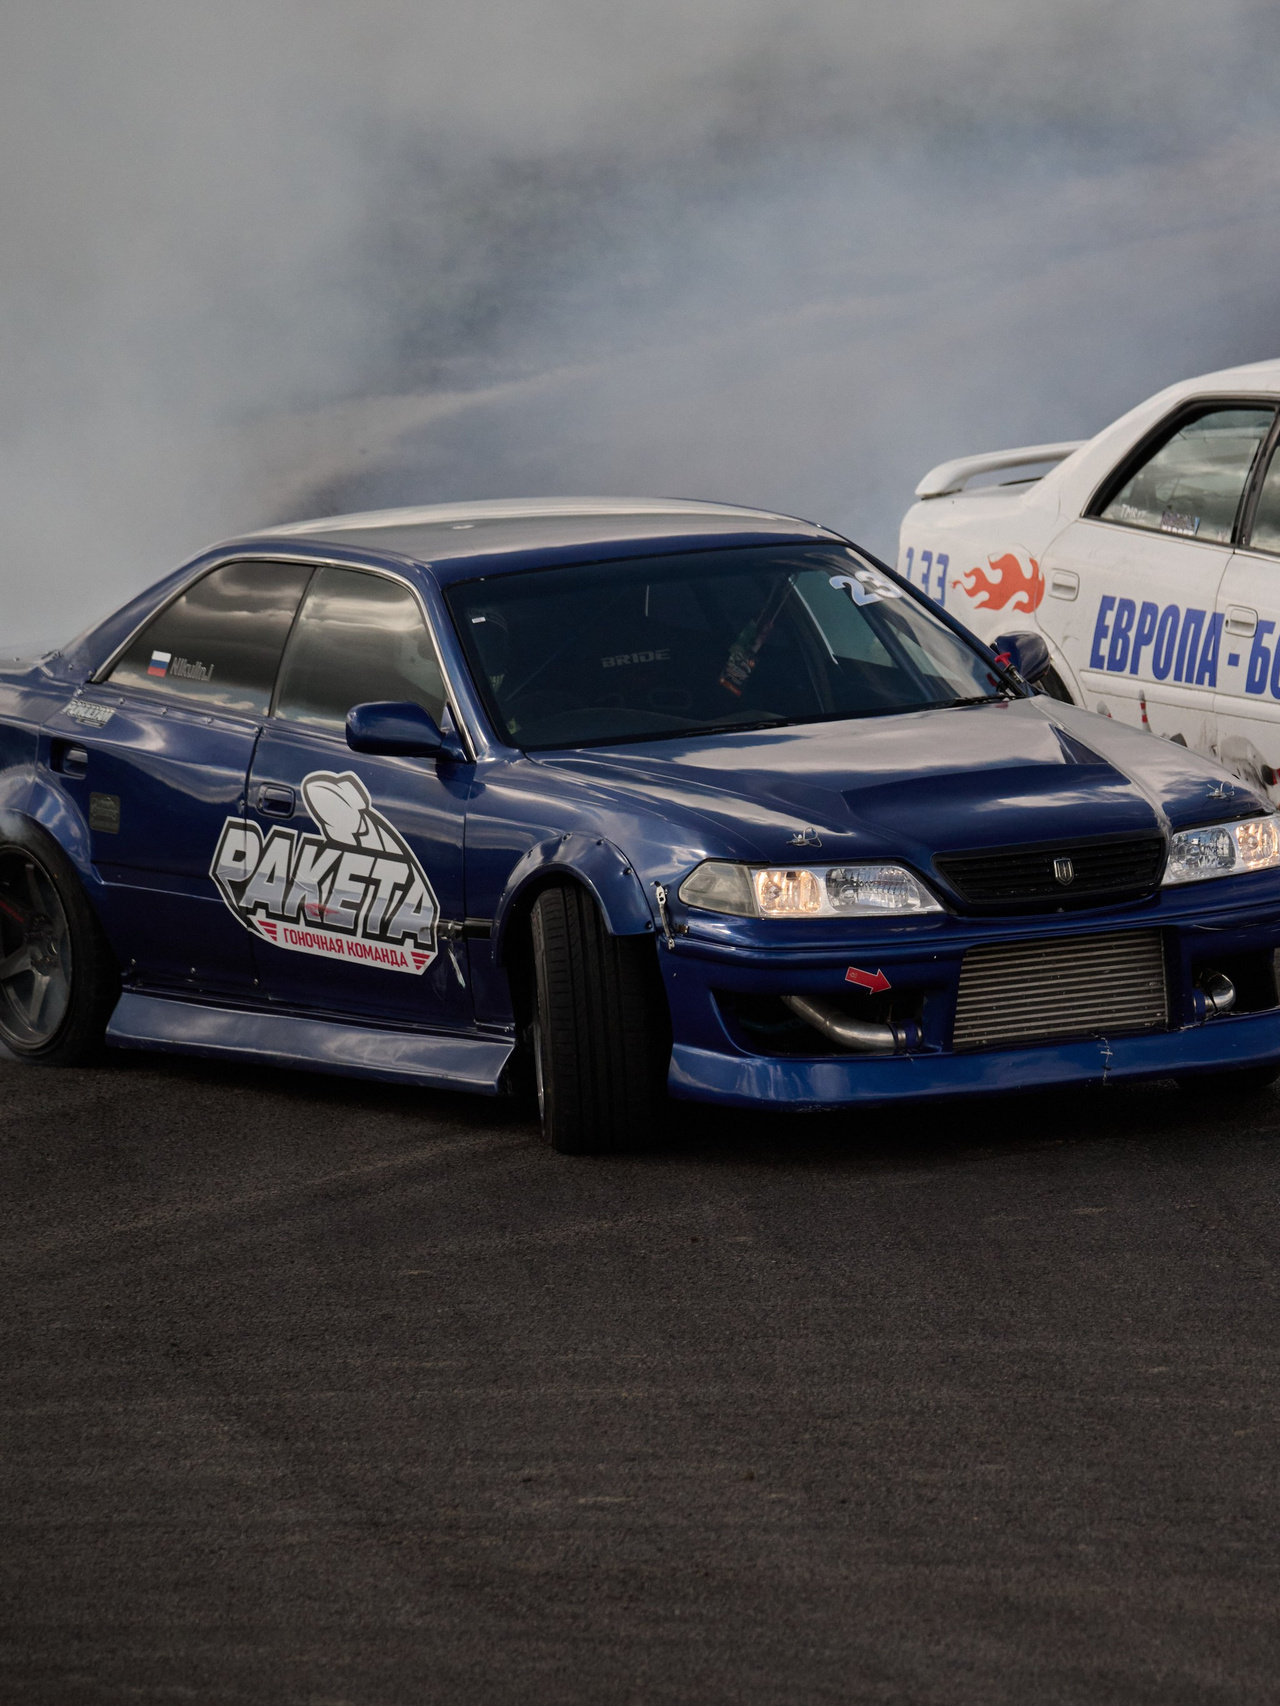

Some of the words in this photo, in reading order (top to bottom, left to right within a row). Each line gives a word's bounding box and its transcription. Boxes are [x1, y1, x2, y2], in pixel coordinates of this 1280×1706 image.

[829, 570, 903, 606] 23
[906, 546, 950, 607] 133
[601, 649, 671, 668] BRIDE
[1089, 594, 1225, 688] ЕВРОПА
[215, 824, 435, 946] РАКЕТА
[283, 927, 346, 950] ГОНОЧНАЯ
[347, 941, 409, 968] КОМАНДА
